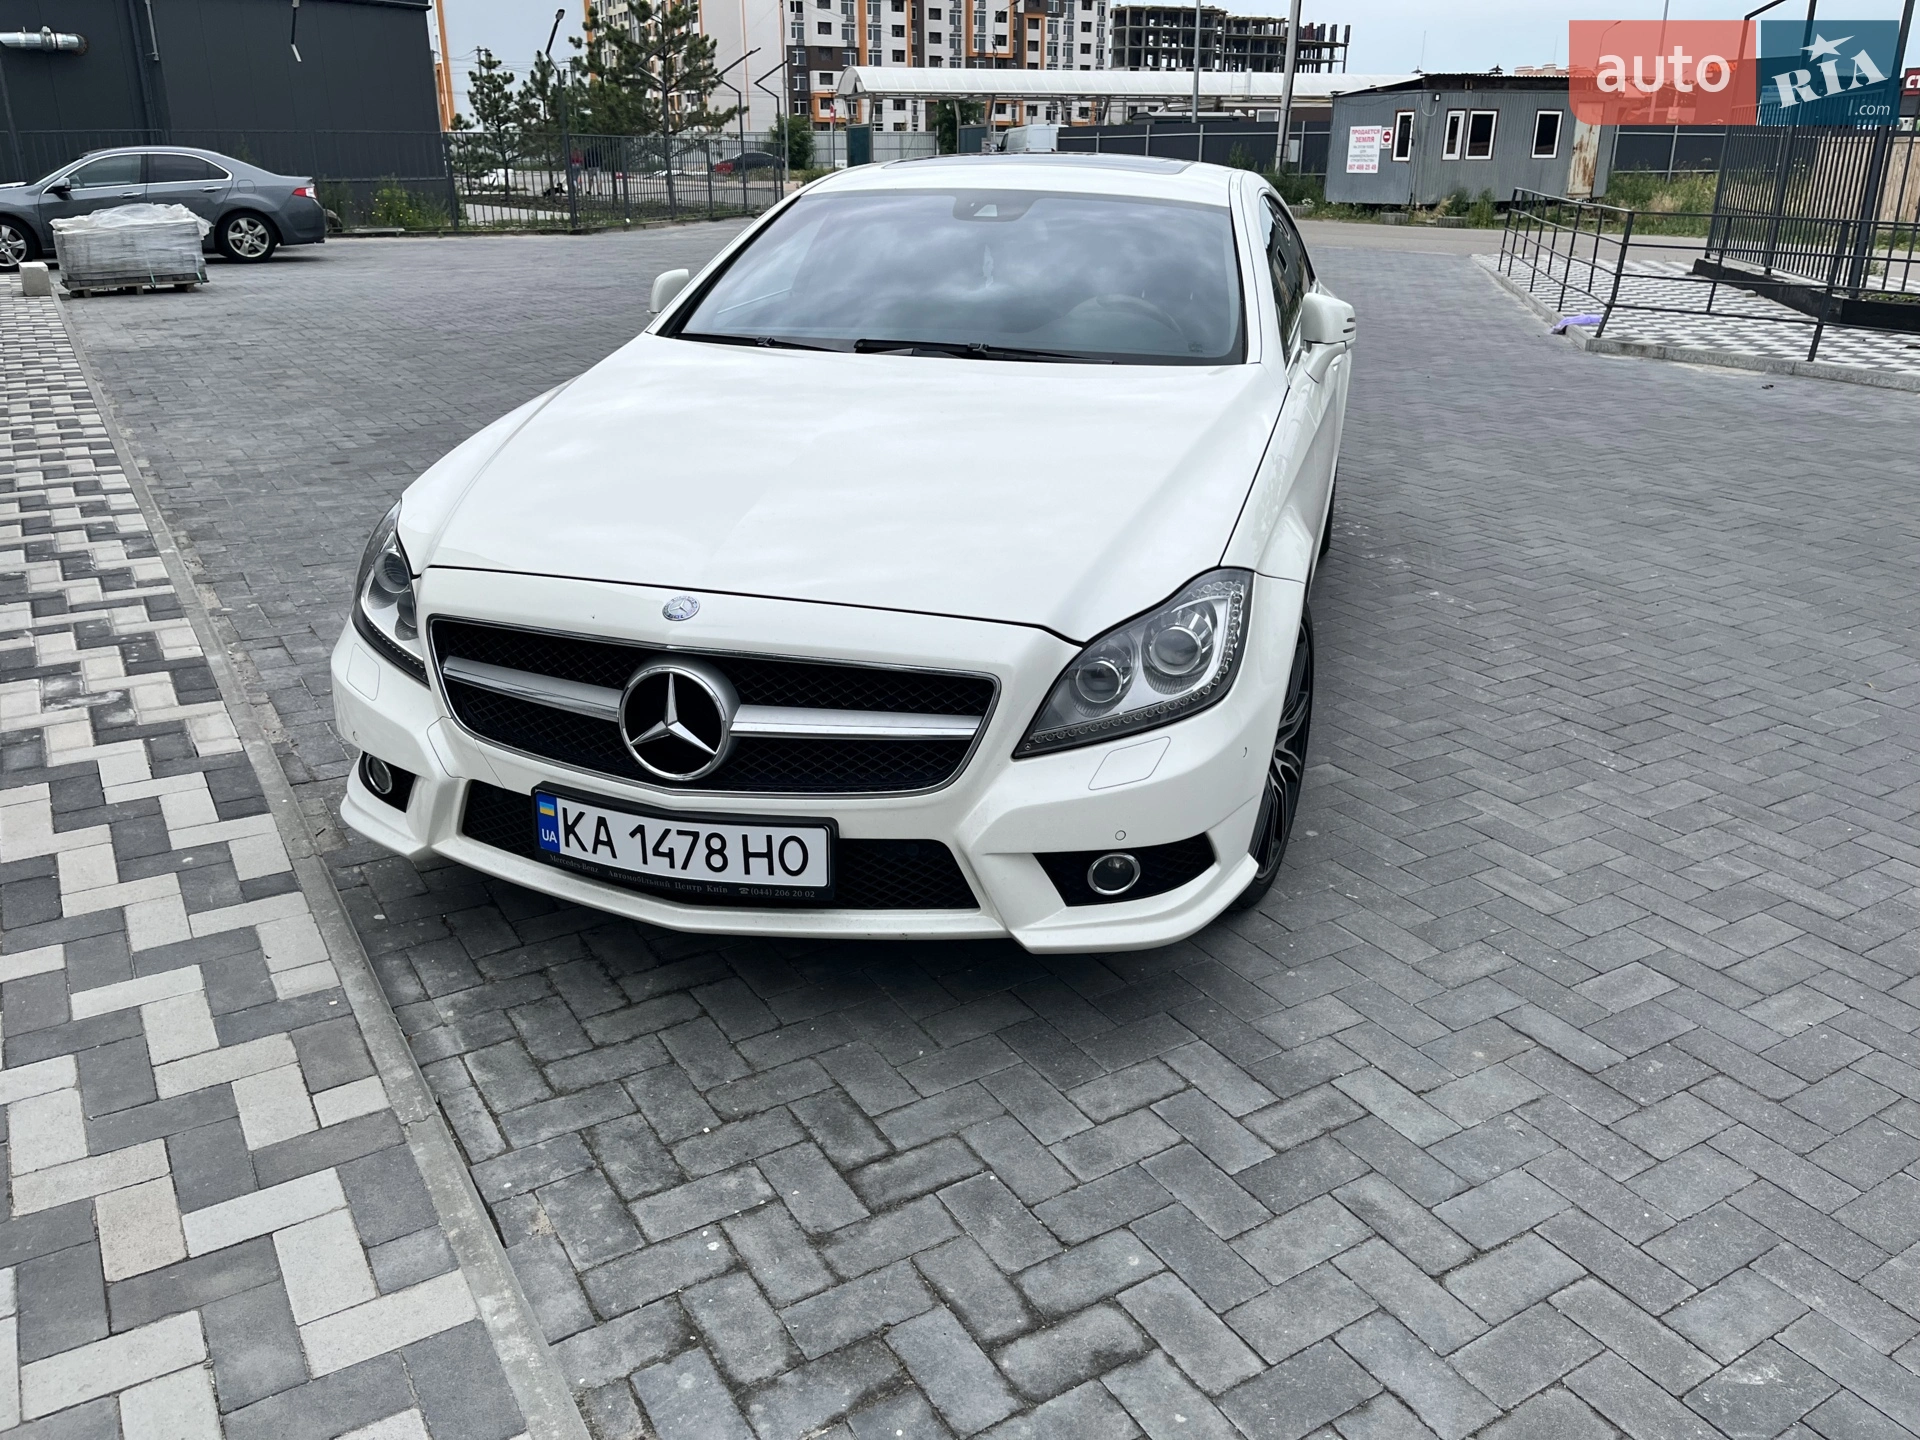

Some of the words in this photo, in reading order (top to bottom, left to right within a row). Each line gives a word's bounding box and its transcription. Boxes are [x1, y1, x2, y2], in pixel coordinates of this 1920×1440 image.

[541, 828, 558, 844] UA
[562, 806, 617, 860] KA
[628, 823, 729, 874] 1478
[741, 833, 810, 877] HO
[674, 882, 703, 893] Центр
[706, 884, 729, 894] Київ
[774, 889, 790, 898] 206
[792, 890, 803, 898] 20
[804, 890, 816, 898] 02
